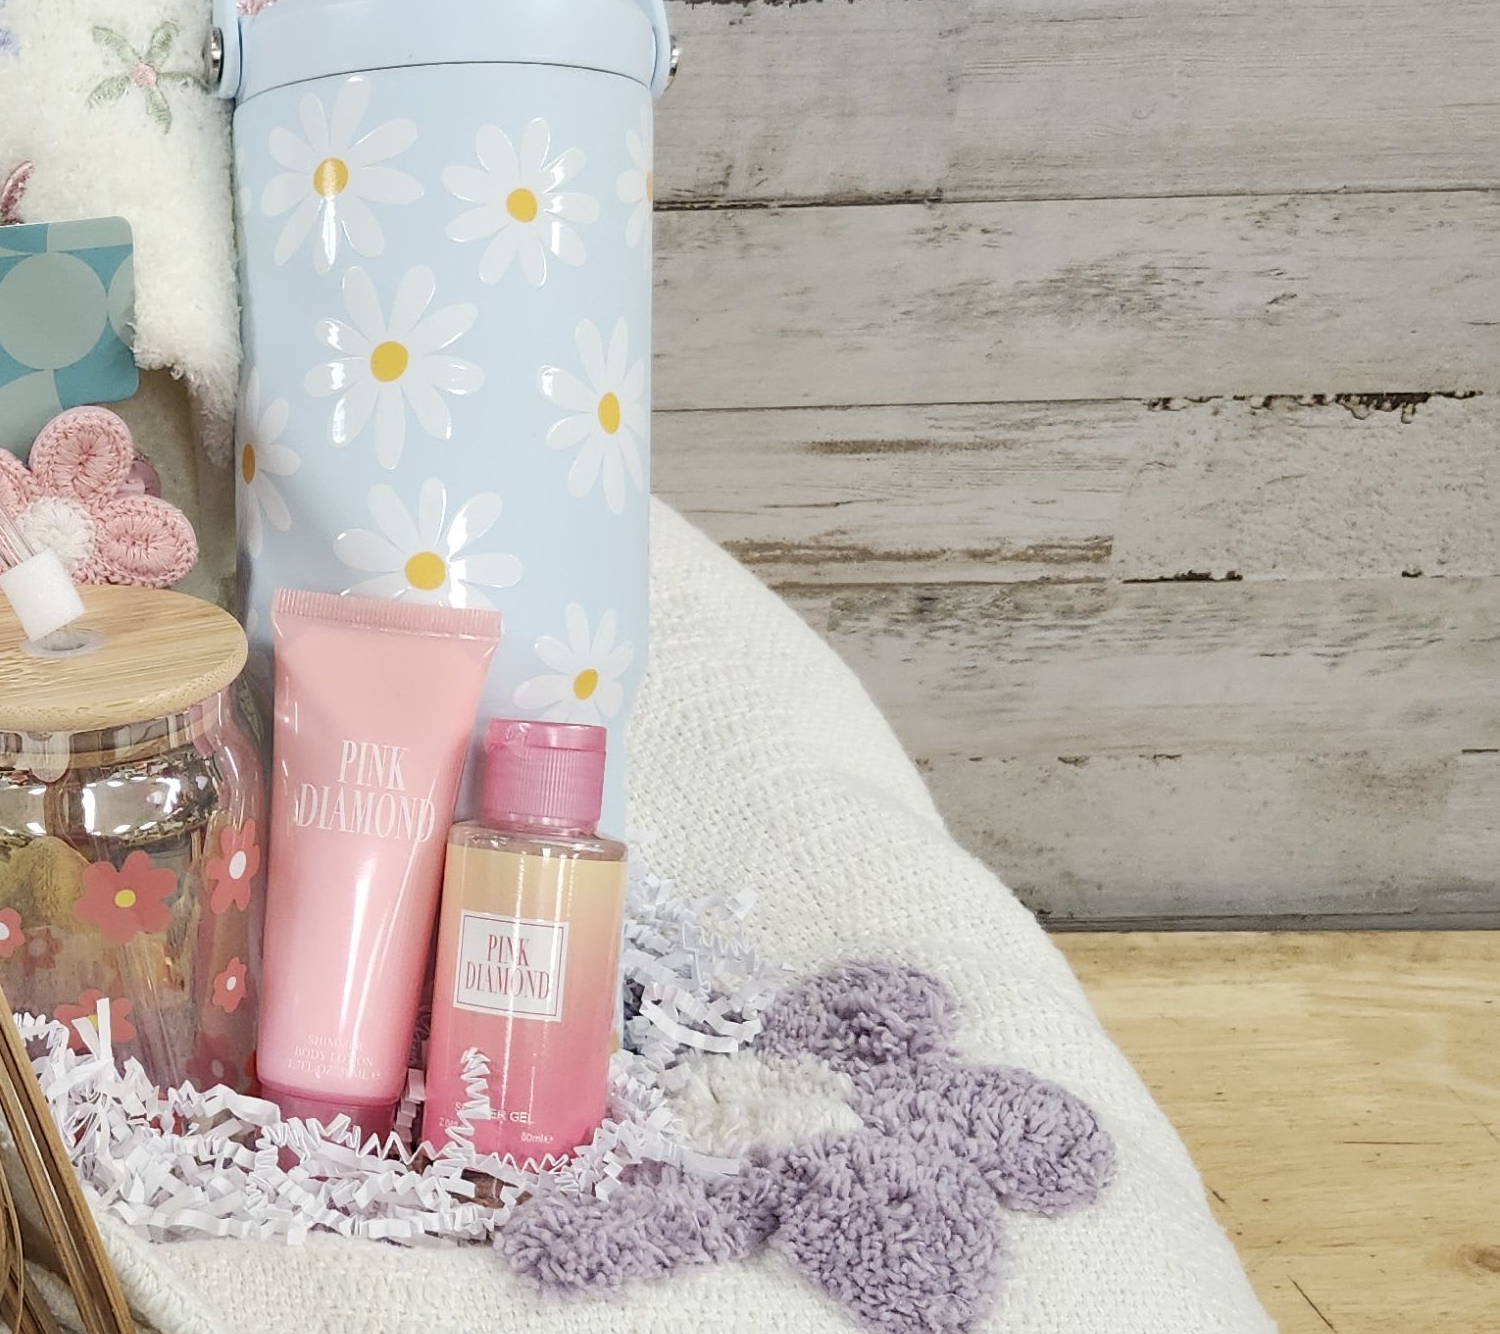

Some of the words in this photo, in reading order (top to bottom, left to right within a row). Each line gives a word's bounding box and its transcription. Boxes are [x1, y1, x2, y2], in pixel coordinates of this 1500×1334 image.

[338, 739, 409, 791] PINK
[296, 783, 435, 843] DIAMOND
[486, 934, 530, 966] PINK
[465, 961, 550, 1000] DIAMOND
[293, 1044, 325, 1061] BODY
[509, 1111, 535, 1125] GEL
